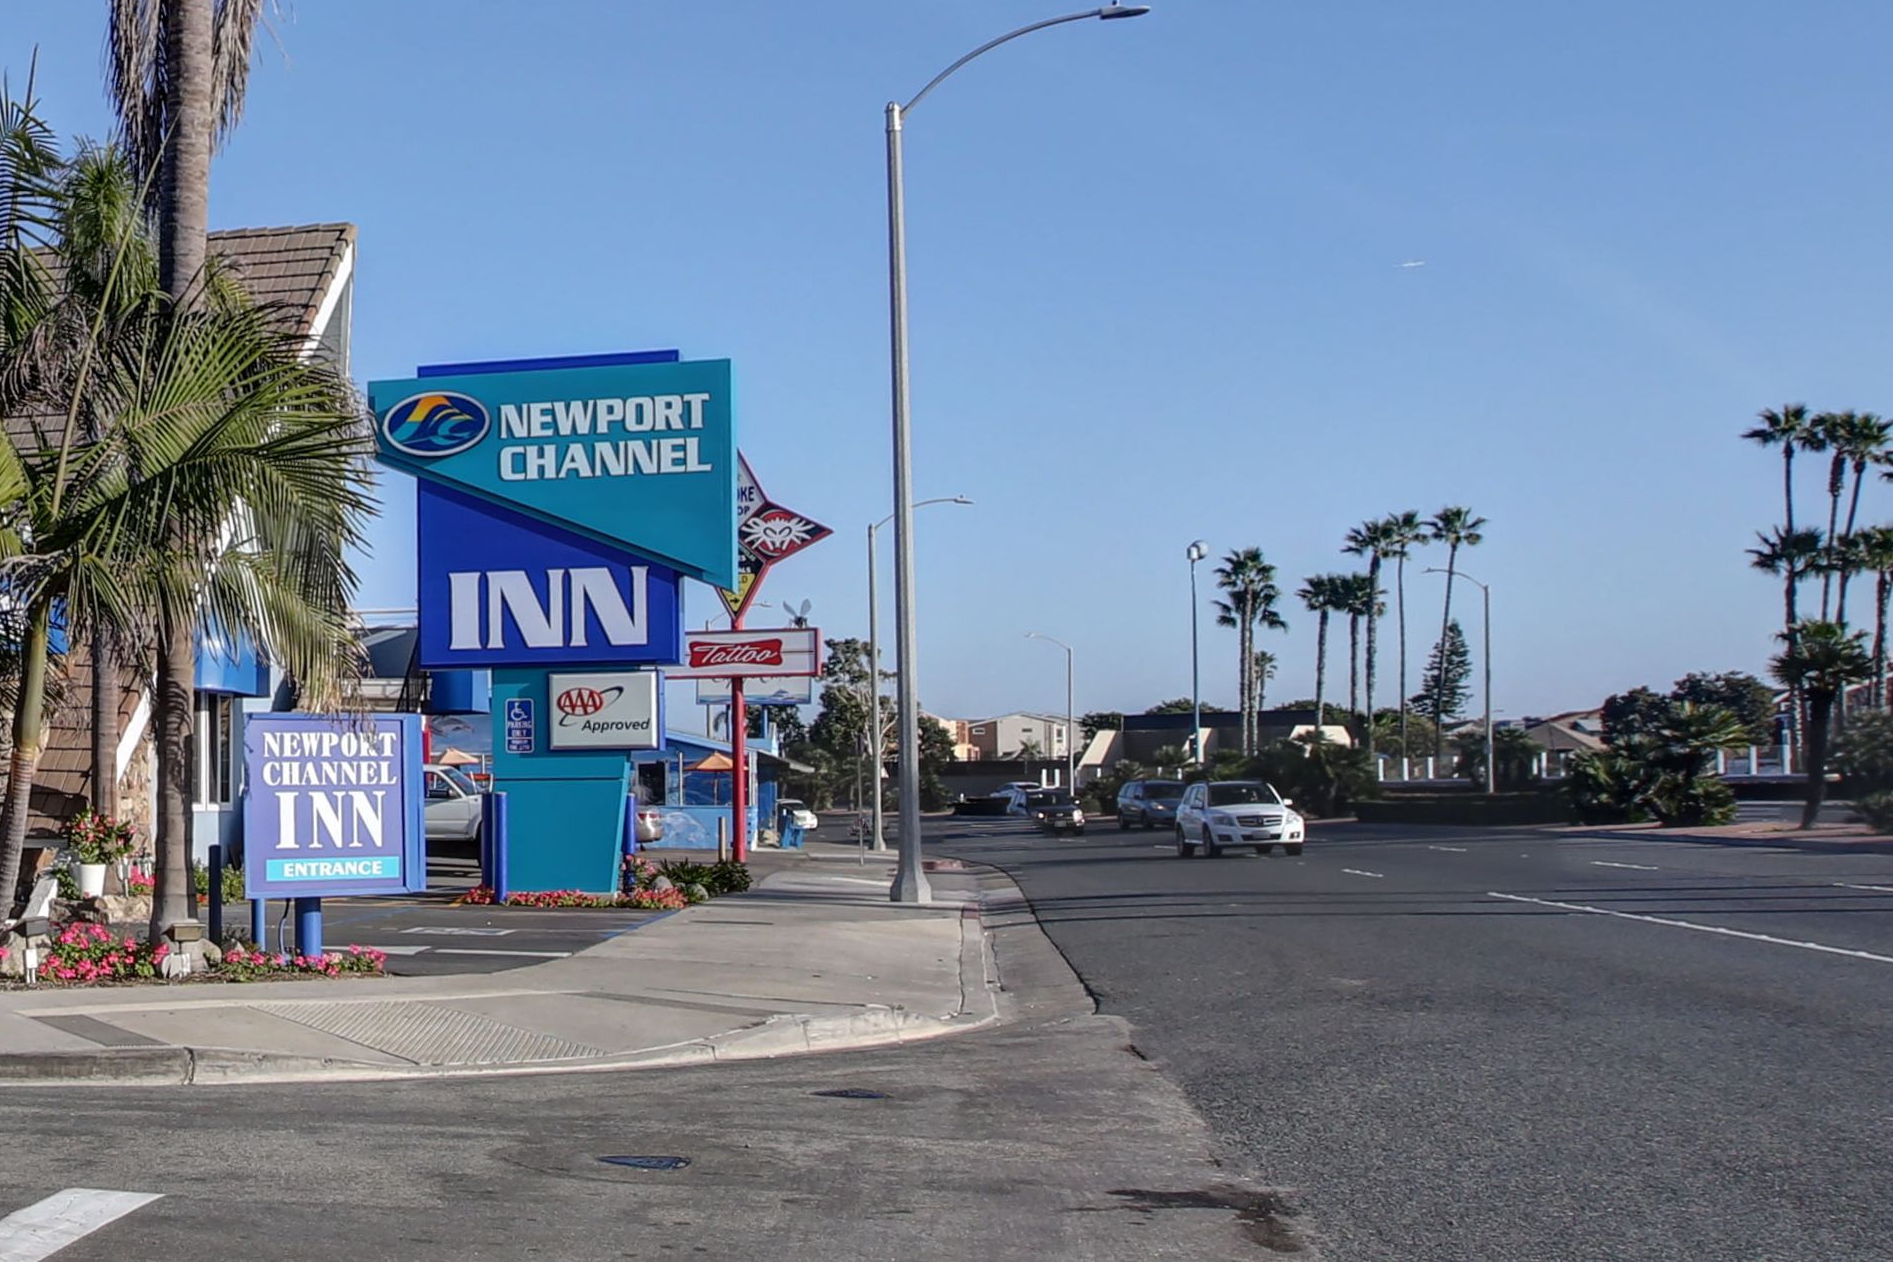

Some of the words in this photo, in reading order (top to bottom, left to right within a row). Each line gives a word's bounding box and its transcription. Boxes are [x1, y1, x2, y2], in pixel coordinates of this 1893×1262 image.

[499, 392, 710, 439] NEWPORT
[499, 437, 713, 481] CHANNEL
[449, 566, 649, 651] INN
[693, 644, 778, 664] Tattoo
[559, 687, 602, 716] AAA
[581, 718, 651, 734] Approved
[262, 730, 397, 760] NEWPORT
[262, 760, 398, 787] CHANNEL
[274, 791, 384, 850] INN
[283, 859, 383, 878] ENTRANCE
